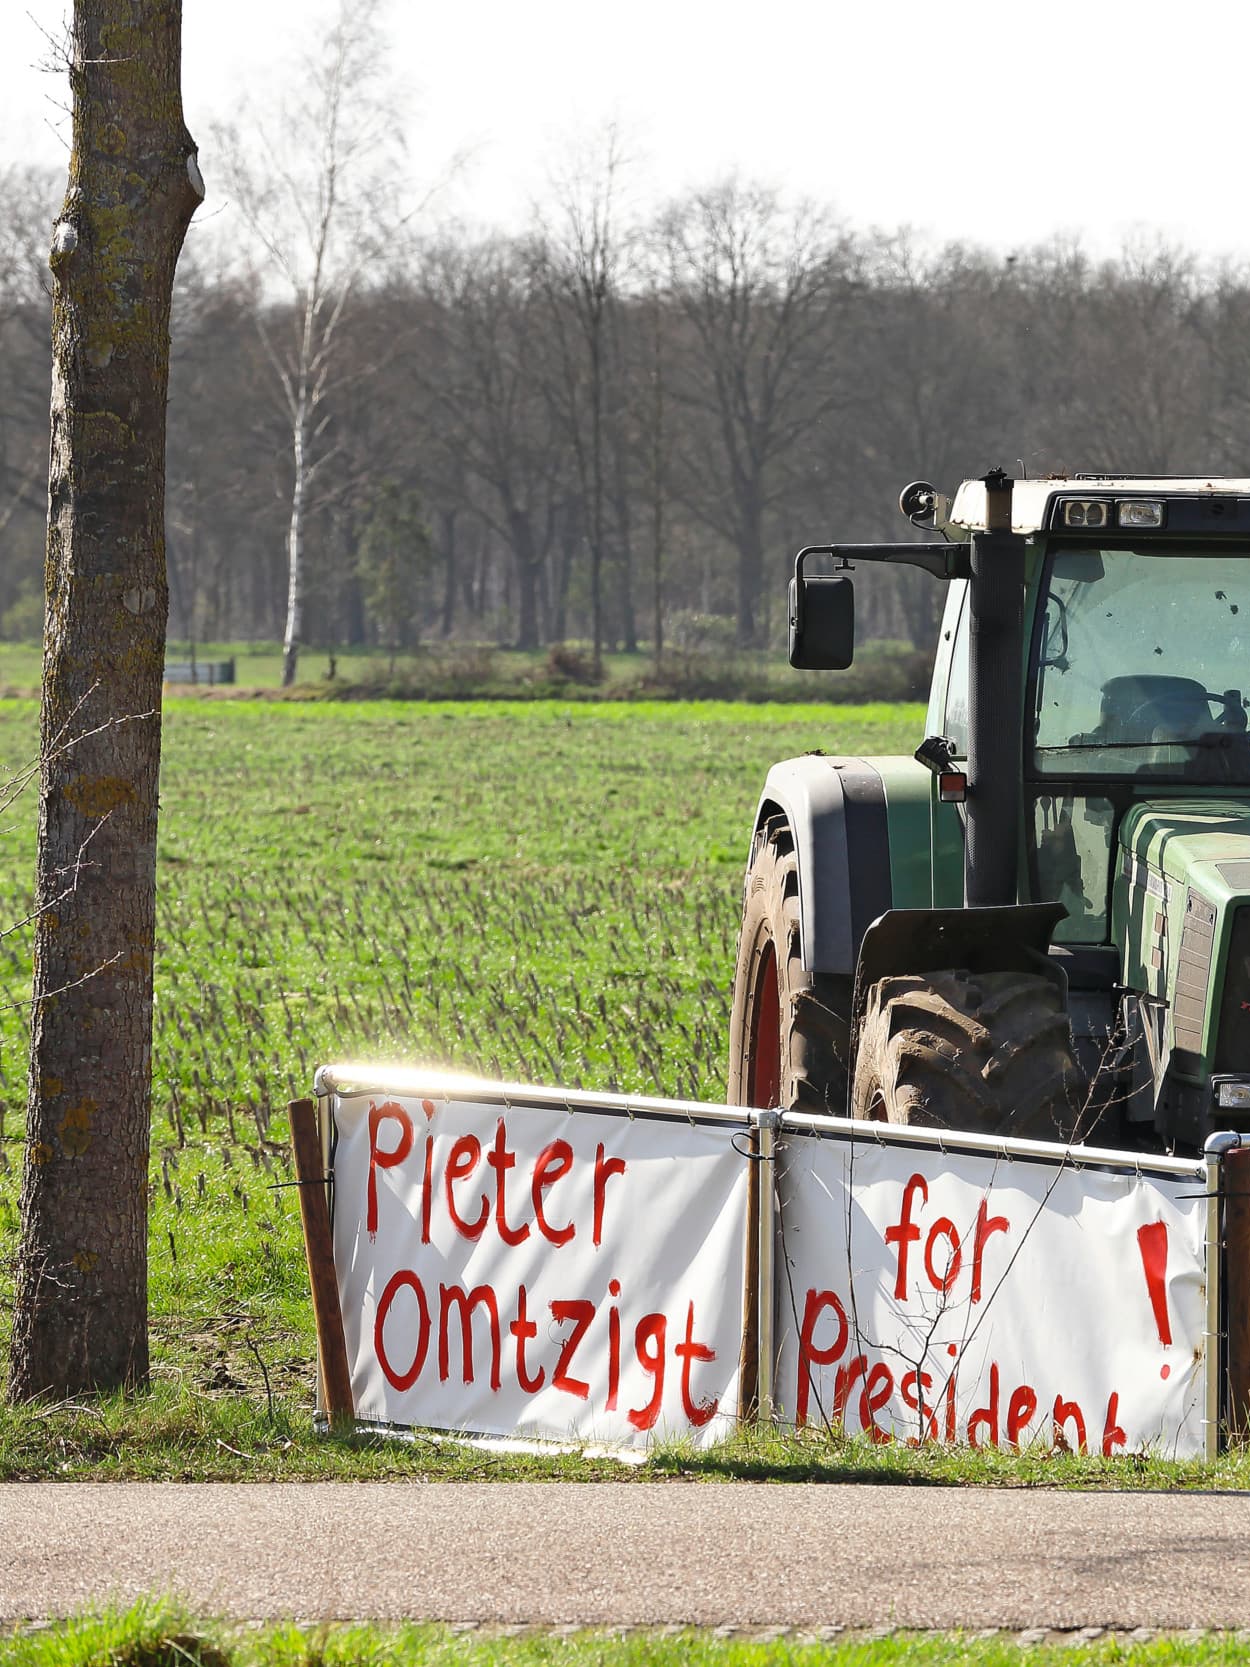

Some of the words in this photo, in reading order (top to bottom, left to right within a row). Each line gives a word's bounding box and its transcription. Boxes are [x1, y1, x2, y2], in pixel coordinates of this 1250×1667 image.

[367, 1099, 628, 1250] Pieter
[885, 1173, 1010, 1304] for
[374, 1269, 718, 1432] Omtzigt
